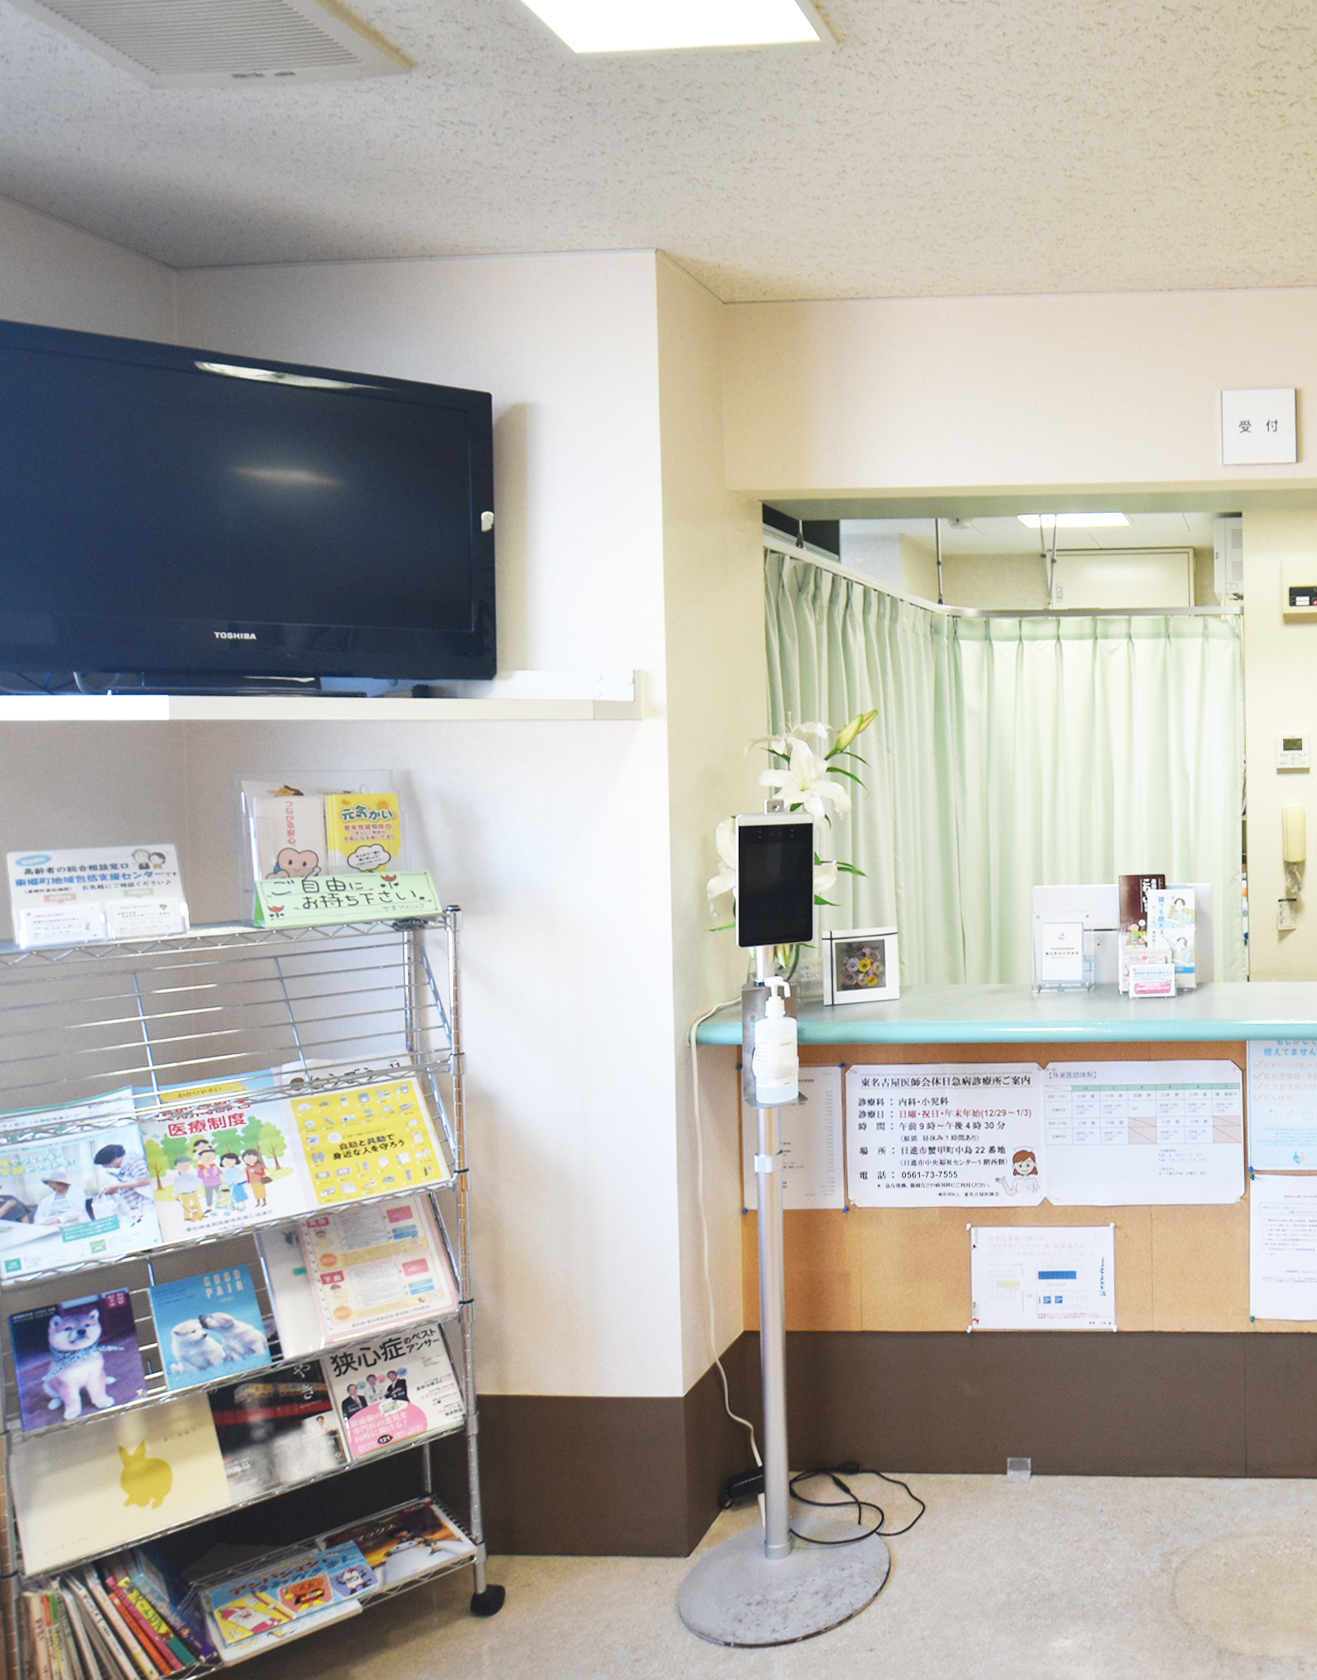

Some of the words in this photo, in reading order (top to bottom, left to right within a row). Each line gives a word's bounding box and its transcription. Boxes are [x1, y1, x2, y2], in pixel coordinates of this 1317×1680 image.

[214, 631, 257, 640] TOSHIBA
[341, 804, 394, 821] 元気かい
[271, 877, 364, 896] ご自由に
[861, 1075, 1031, 1088] 東名古屋医師会休日急病診療所ご案内
[168, 1113, 247, 1137] 医療制度
[332, 1140, 406, 1161] 身近な人を守ろう
[203, 1269, 242, 1287] GOOD
[205, 1280, 245, 1299] PAIR
[403, 1328, 437, 1345] のベスト
[406, 1338, 439, 1354] アンサー
[330, 1337, 406, 1378] 狭心症
